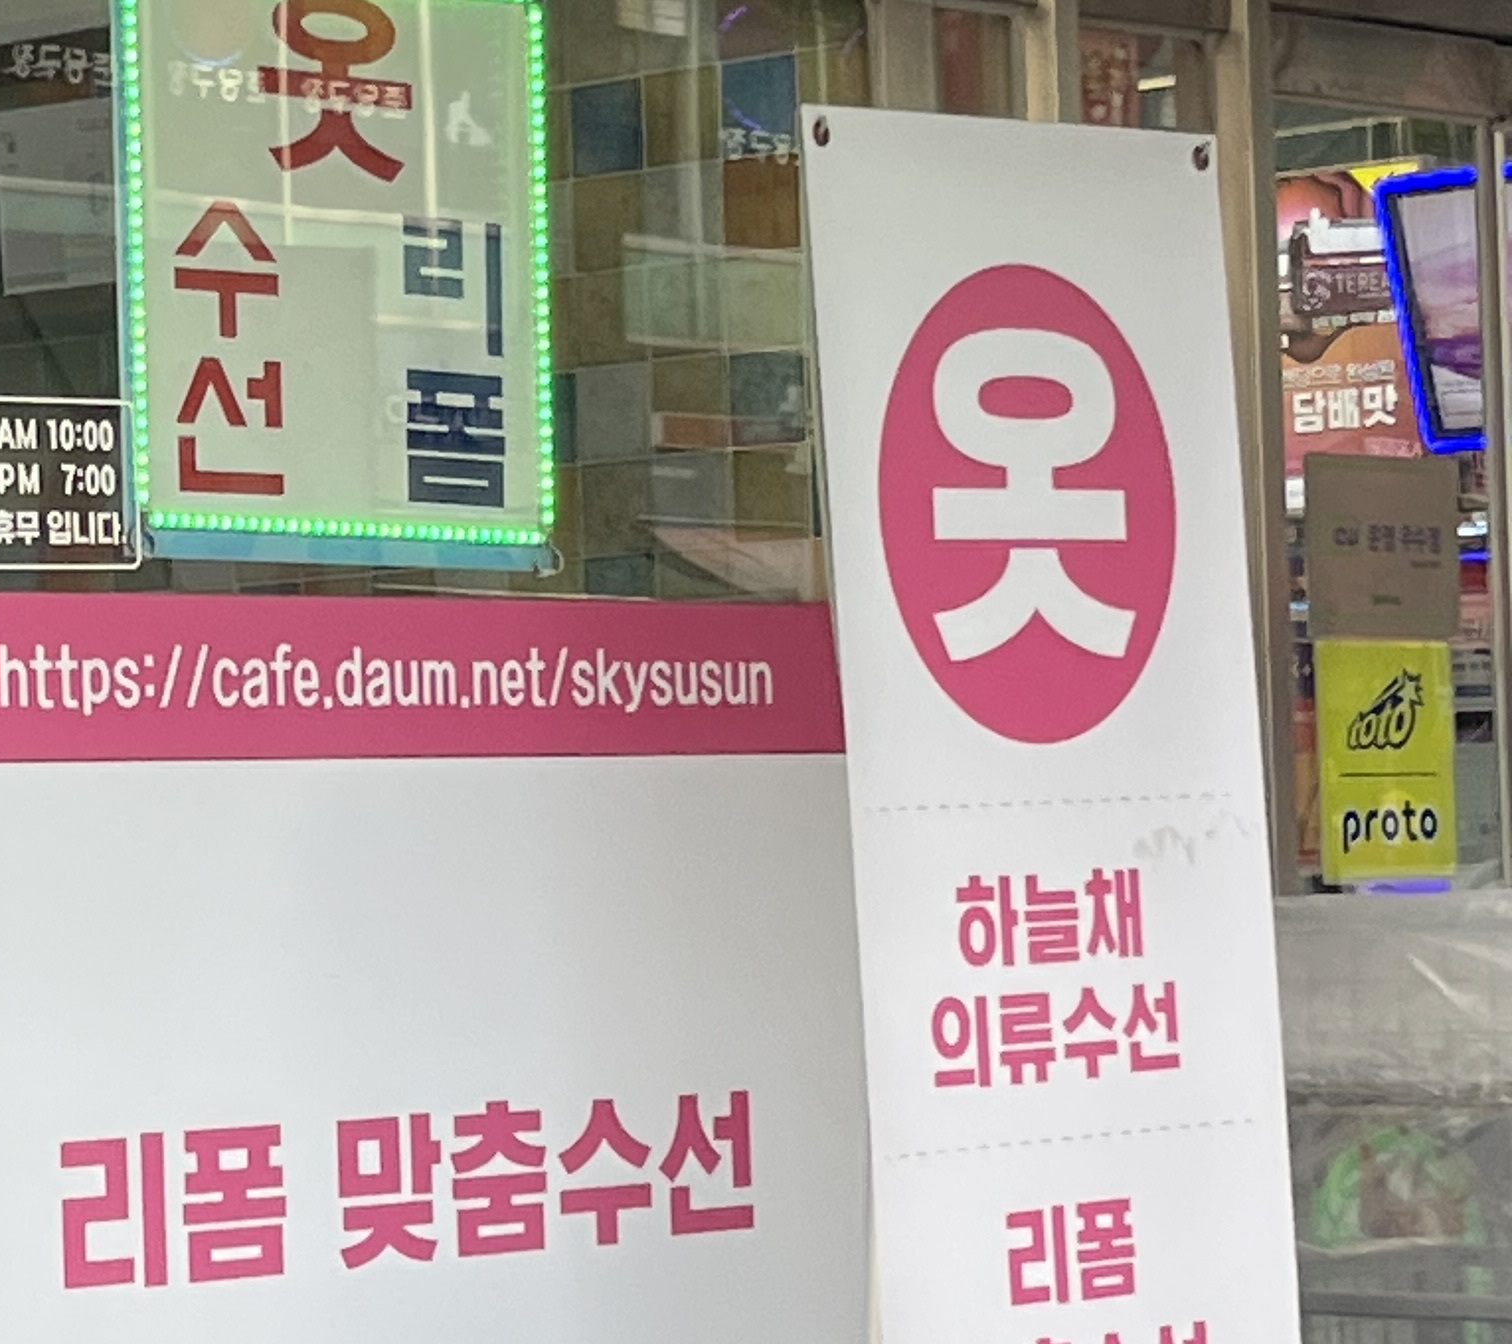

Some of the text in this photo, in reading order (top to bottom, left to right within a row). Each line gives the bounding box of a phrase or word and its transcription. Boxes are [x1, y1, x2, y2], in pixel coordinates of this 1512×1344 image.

[174, 201, 285, 495] 수선
[45, 418, 115, 452] 10:00
[1293, 383, 1398, 434] 담배맛
[61, 464, 116, 497] 7:00
[933, 327, 1137, 663] 옷
[1342, 801, 1438, 854] proto
[955, 866, 1144, 970] 하늘채
[931, 982, 1182, 1089] 의류수선
[60, 1089, 755, 1290] 리폼 맞춤수선
[1005, 1197, 1137, 1309] 리폼
